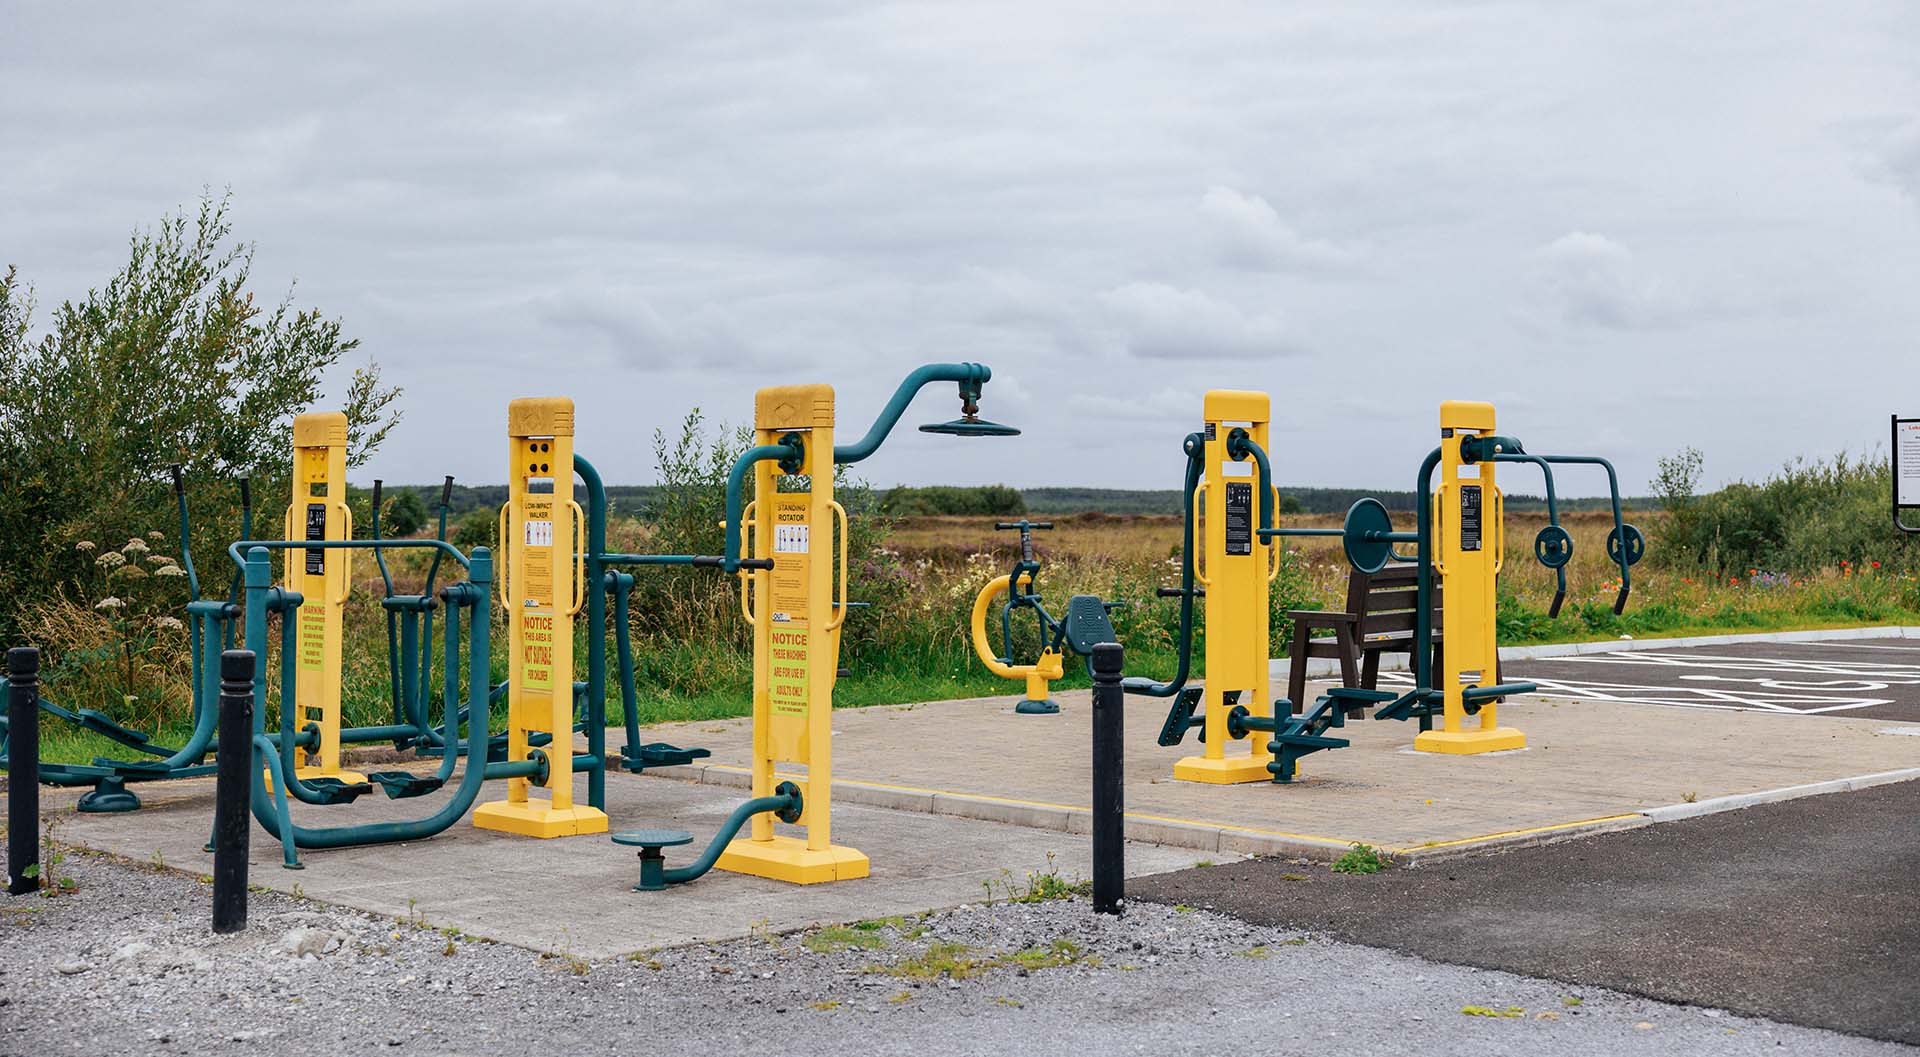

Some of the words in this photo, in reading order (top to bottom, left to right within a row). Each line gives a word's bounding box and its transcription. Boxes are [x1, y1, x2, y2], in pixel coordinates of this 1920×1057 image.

[777, 504, 807, 512] STANDING
[524, 616, 552, 630] NOTICE
[525, 632, 535, 641] THIS
[536, 632, 547, 642] AREA
[772, 633, 808, 646] NOTICE
[533, 646, 552, 665] SUITABLE
[773, 648, 786, 659] THESE
[787, 650, 807, 661] MACHINES
[774, 667, 782, 678] ARE
[791, 668, 799, 679] USE
[776, 685, 791, 696] ADULTS
[792, 687, 803, 697] ONLY
